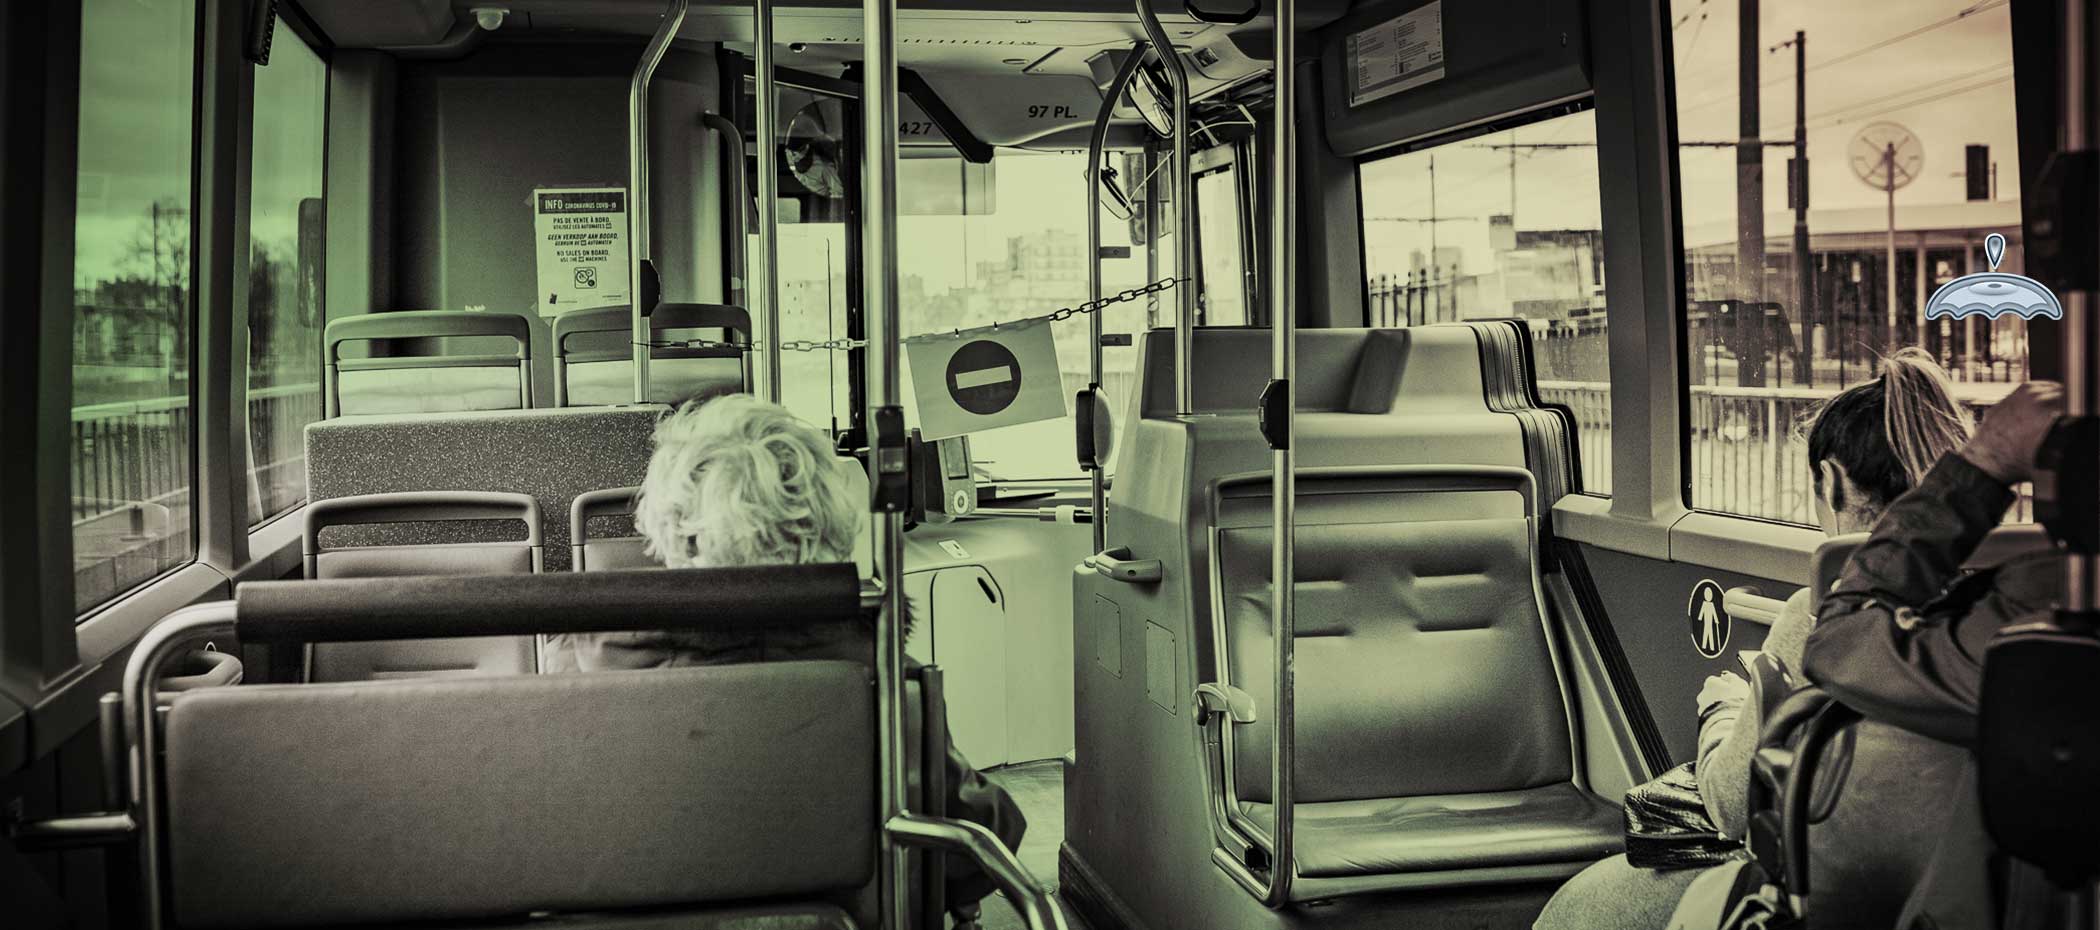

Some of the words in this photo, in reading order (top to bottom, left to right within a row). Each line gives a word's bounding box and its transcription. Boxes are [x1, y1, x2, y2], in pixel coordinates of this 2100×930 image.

[1028, 105, 1049, 119] 97
[1054, 105, 1078, 119] PL.
[545, 199, 563, 210] INFO
